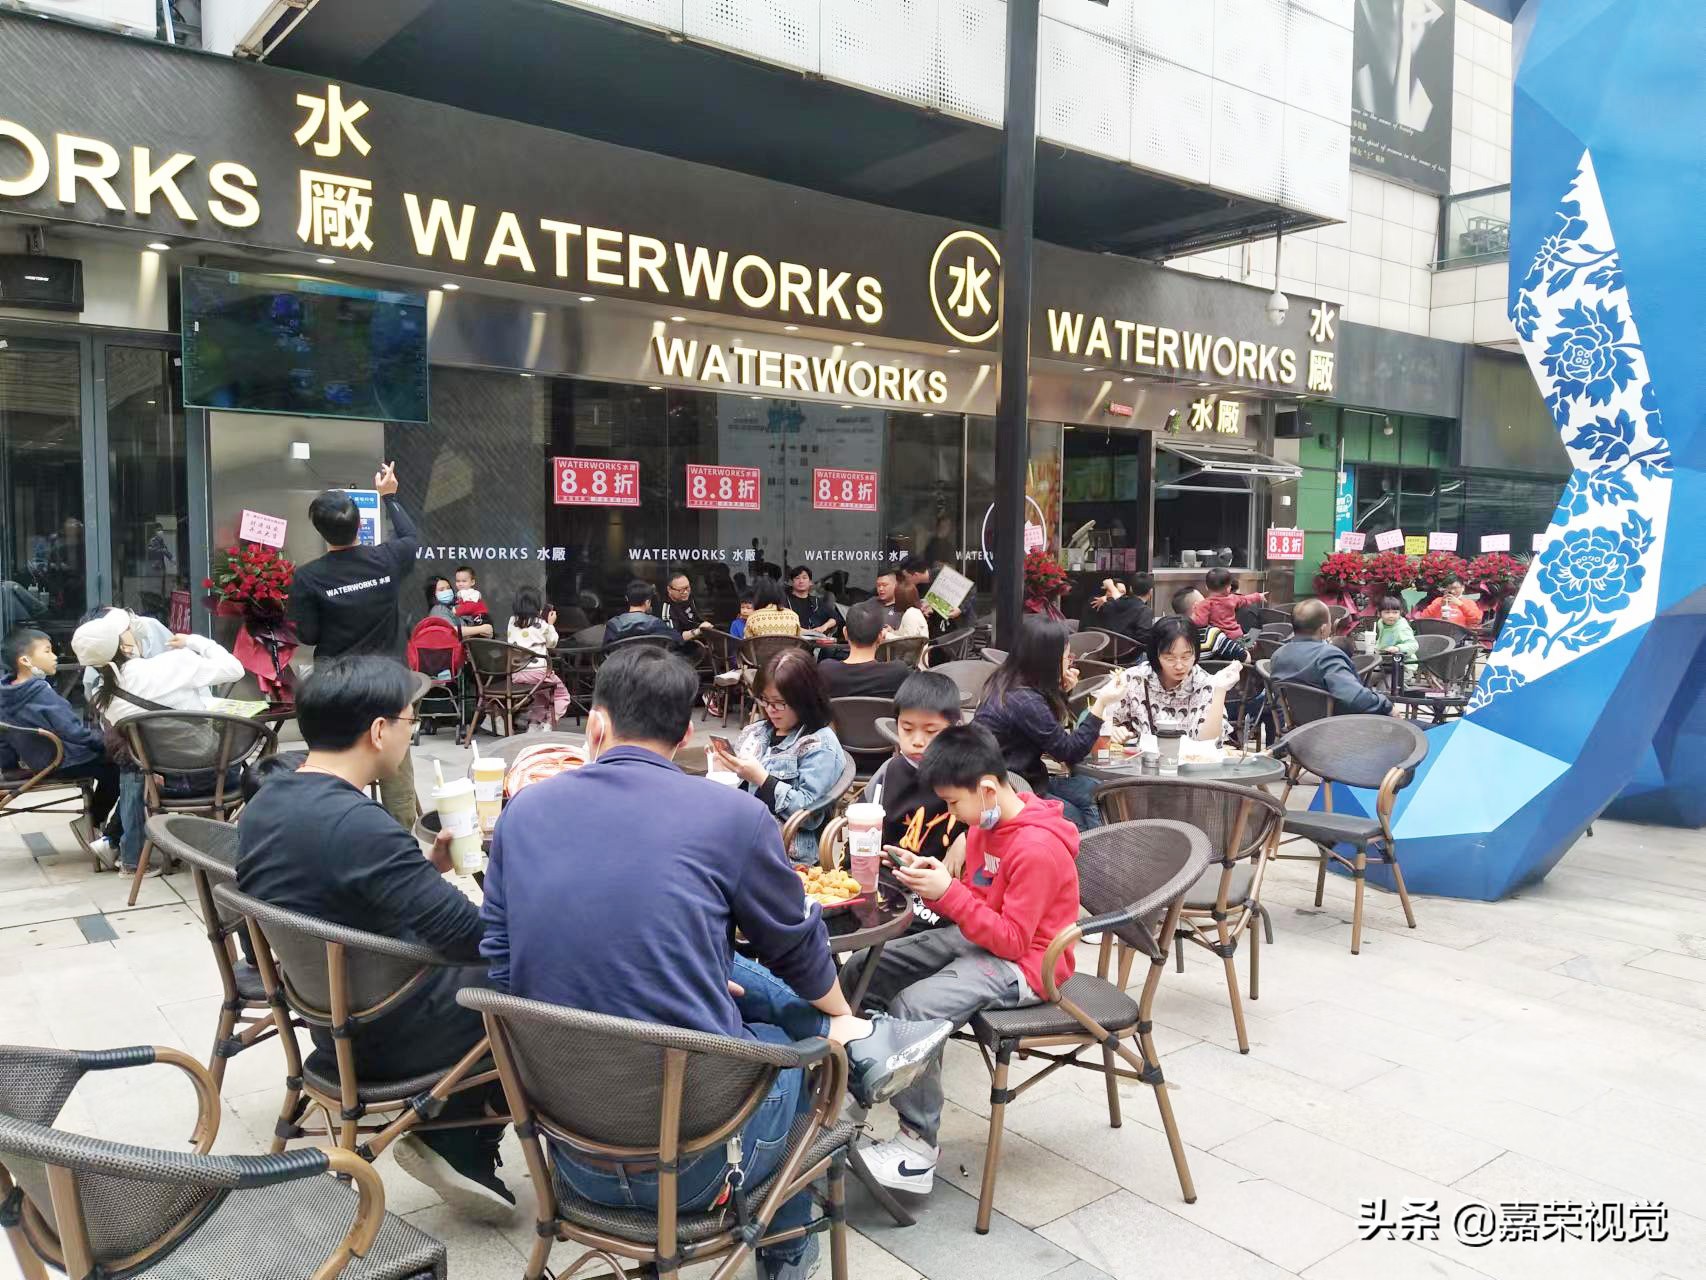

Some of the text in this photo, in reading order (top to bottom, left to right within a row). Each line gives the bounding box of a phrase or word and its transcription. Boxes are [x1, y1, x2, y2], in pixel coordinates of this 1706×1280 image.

[294, 84, 374, 252] 水廠
[403, 191, 884, 325] WATERWORKS
[946, 255, 992, 318] 水
[1047, 308, 1297, 384] WATERWORKS
[1307, 301, 1335, 393] 水廠
[656, 335, 949, 404] WATERWORKS
[1191, 397, 1240, 434] 水廠
[558, 460, 622, 470] WATERWORKS
[690, 467, 745, 477] WATERWORKS
[816, 471, 865, 480] WATERWORKS
[537, 547, 566, 561] 水廠
[629, 548, 726, 561] WATERWORKS
[804, 550, 884, 561] WATERWORKS
[326, 579, 378, 597] WATERWORKS
